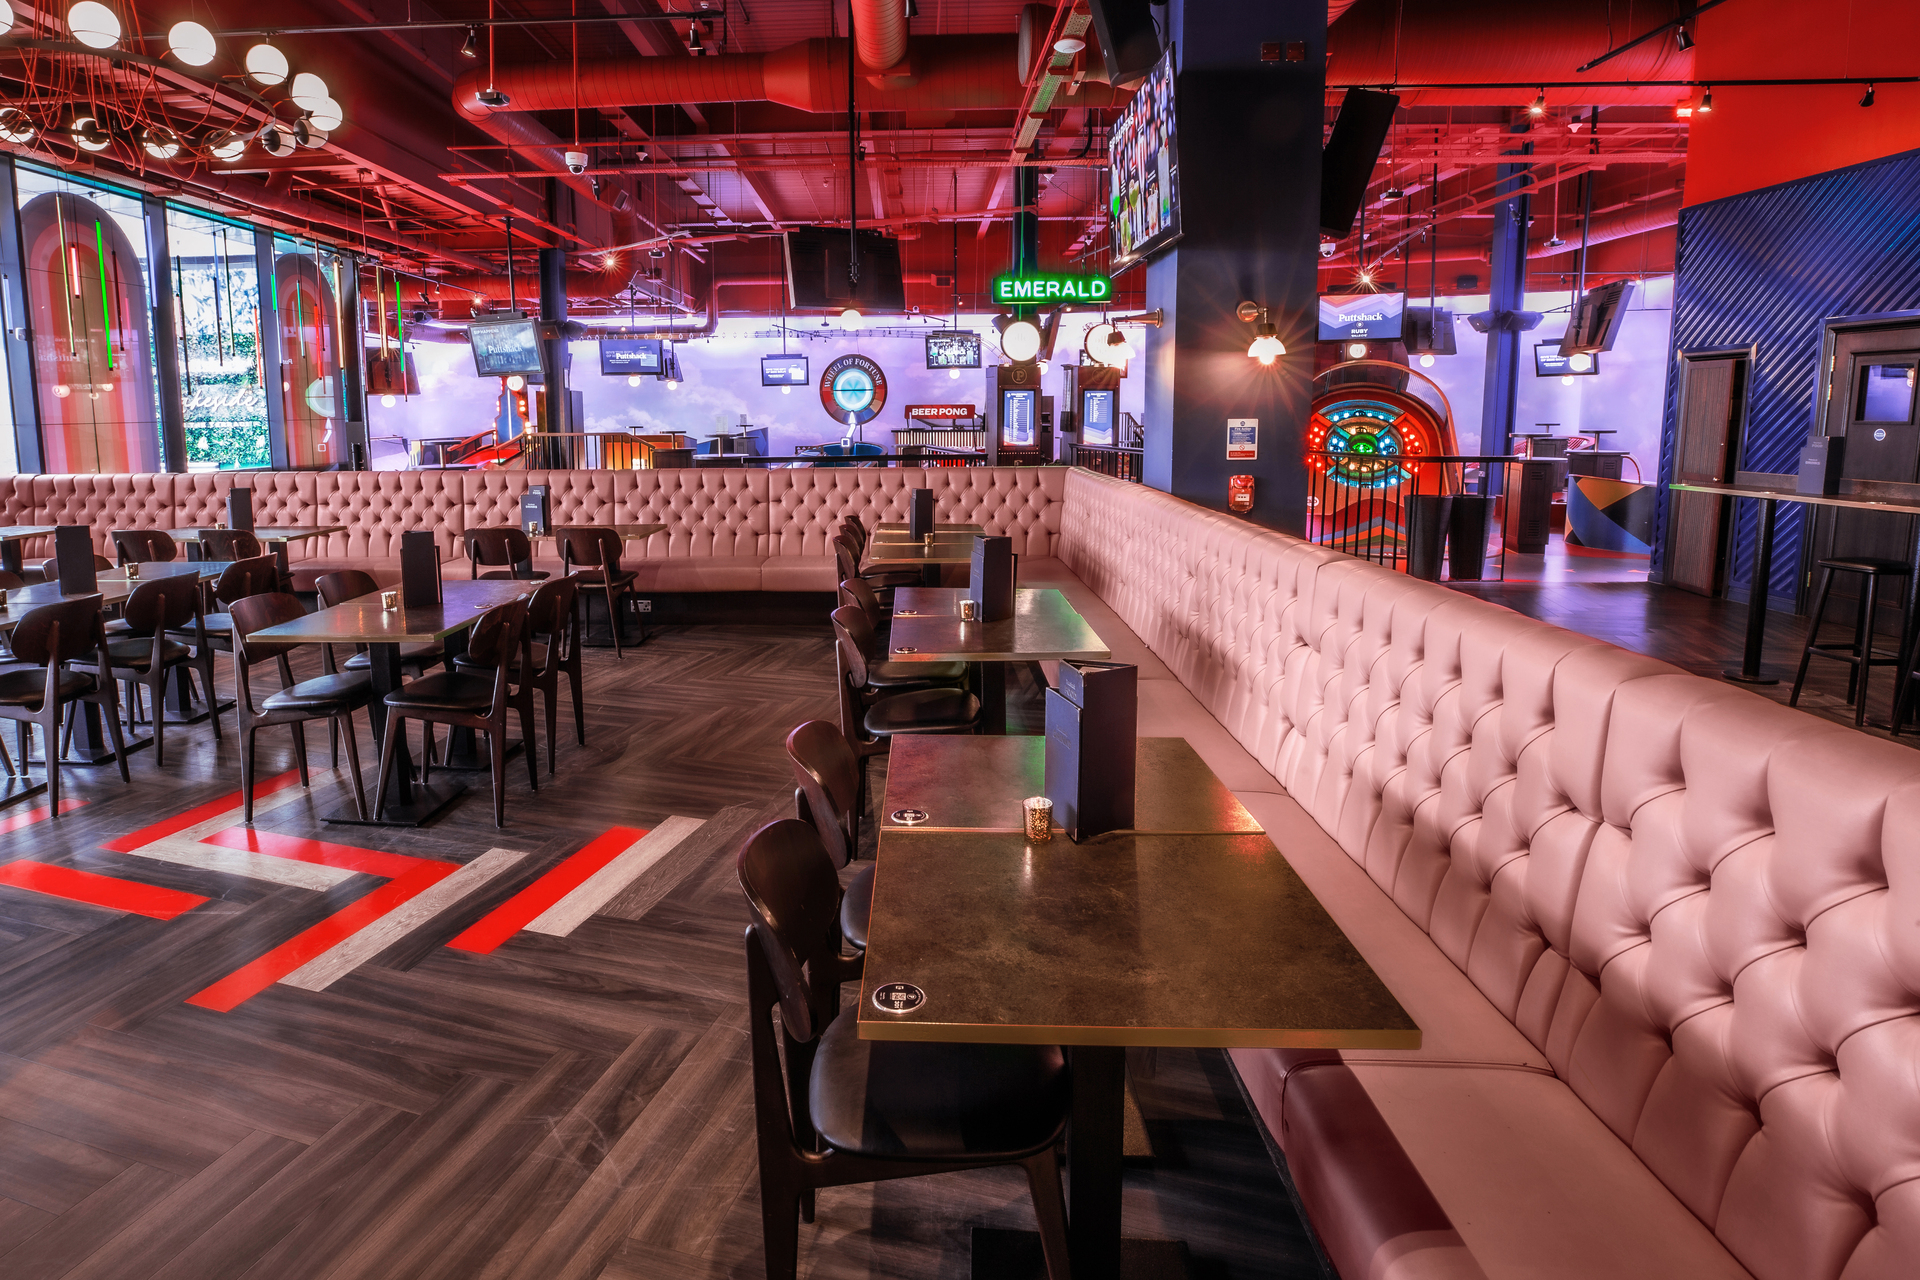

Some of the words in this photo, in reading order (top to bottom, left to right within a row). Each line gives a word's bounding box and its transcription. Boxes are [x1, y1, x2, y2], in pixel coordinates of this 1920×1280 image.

[1000, 280, 1106, 297] EMERALD
[1339, 312, 1383, 321] Puttshack
[488, 344, 523, 354] Puttshack
[615, 352, 647, 360] Puttshack
[824, 362, 843, 388] WHEEL
[843, 358, 854, 366] OF
[855, 358, 883, 386] FORTUNE
[911, 408, 938, 416] BEER
[939, 407, 968, 416] PONG
